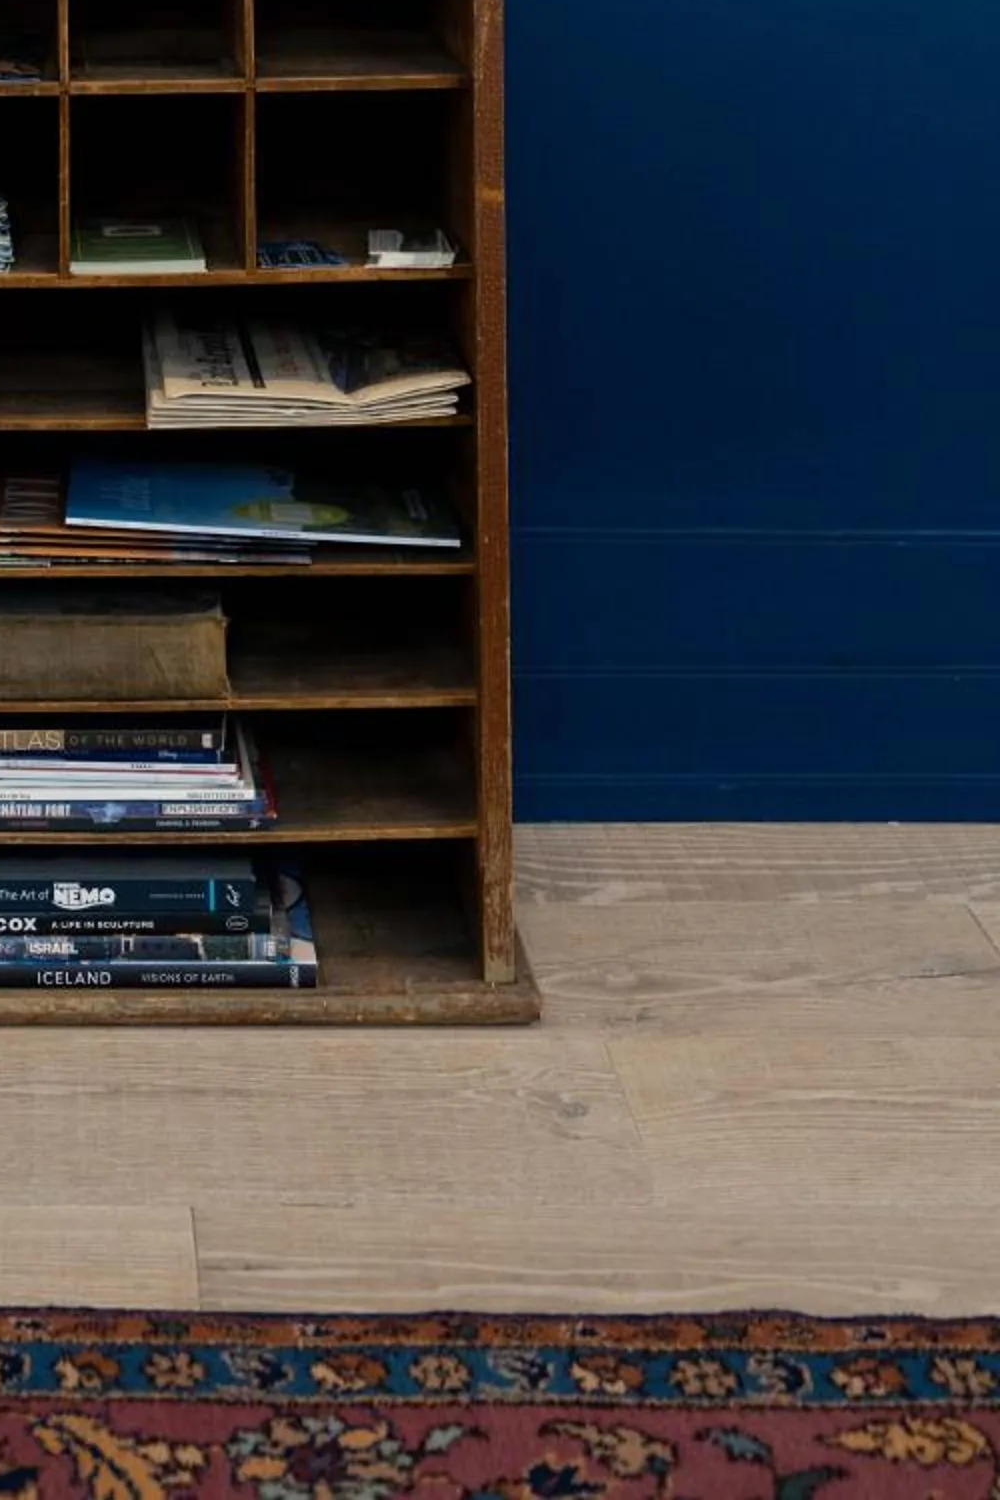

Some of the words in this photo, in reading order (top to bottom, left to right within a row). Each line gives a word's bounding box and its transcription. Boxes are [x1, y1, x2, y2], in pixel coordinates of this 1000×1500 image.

[69, 736, 89, 747] OF
[95, 736, 124, 747] THE
[132, 736, 188, 747] WORLD
[45, 803, 72, 817] FORT
[20, 889, 36, 901] Art
[38, 889, 49, 901] of
[53, 886, 116, 906] NEMO
[60, 921, 81, 929] LIFE
[83, 921, 95, 929] IN
[97, 921, 155, 930] SCULPTURE
[36, 971, 112, 985] ICELAND
[141, 972, 180, 984] VISIONS
[183, 972, 199, 984] OF
